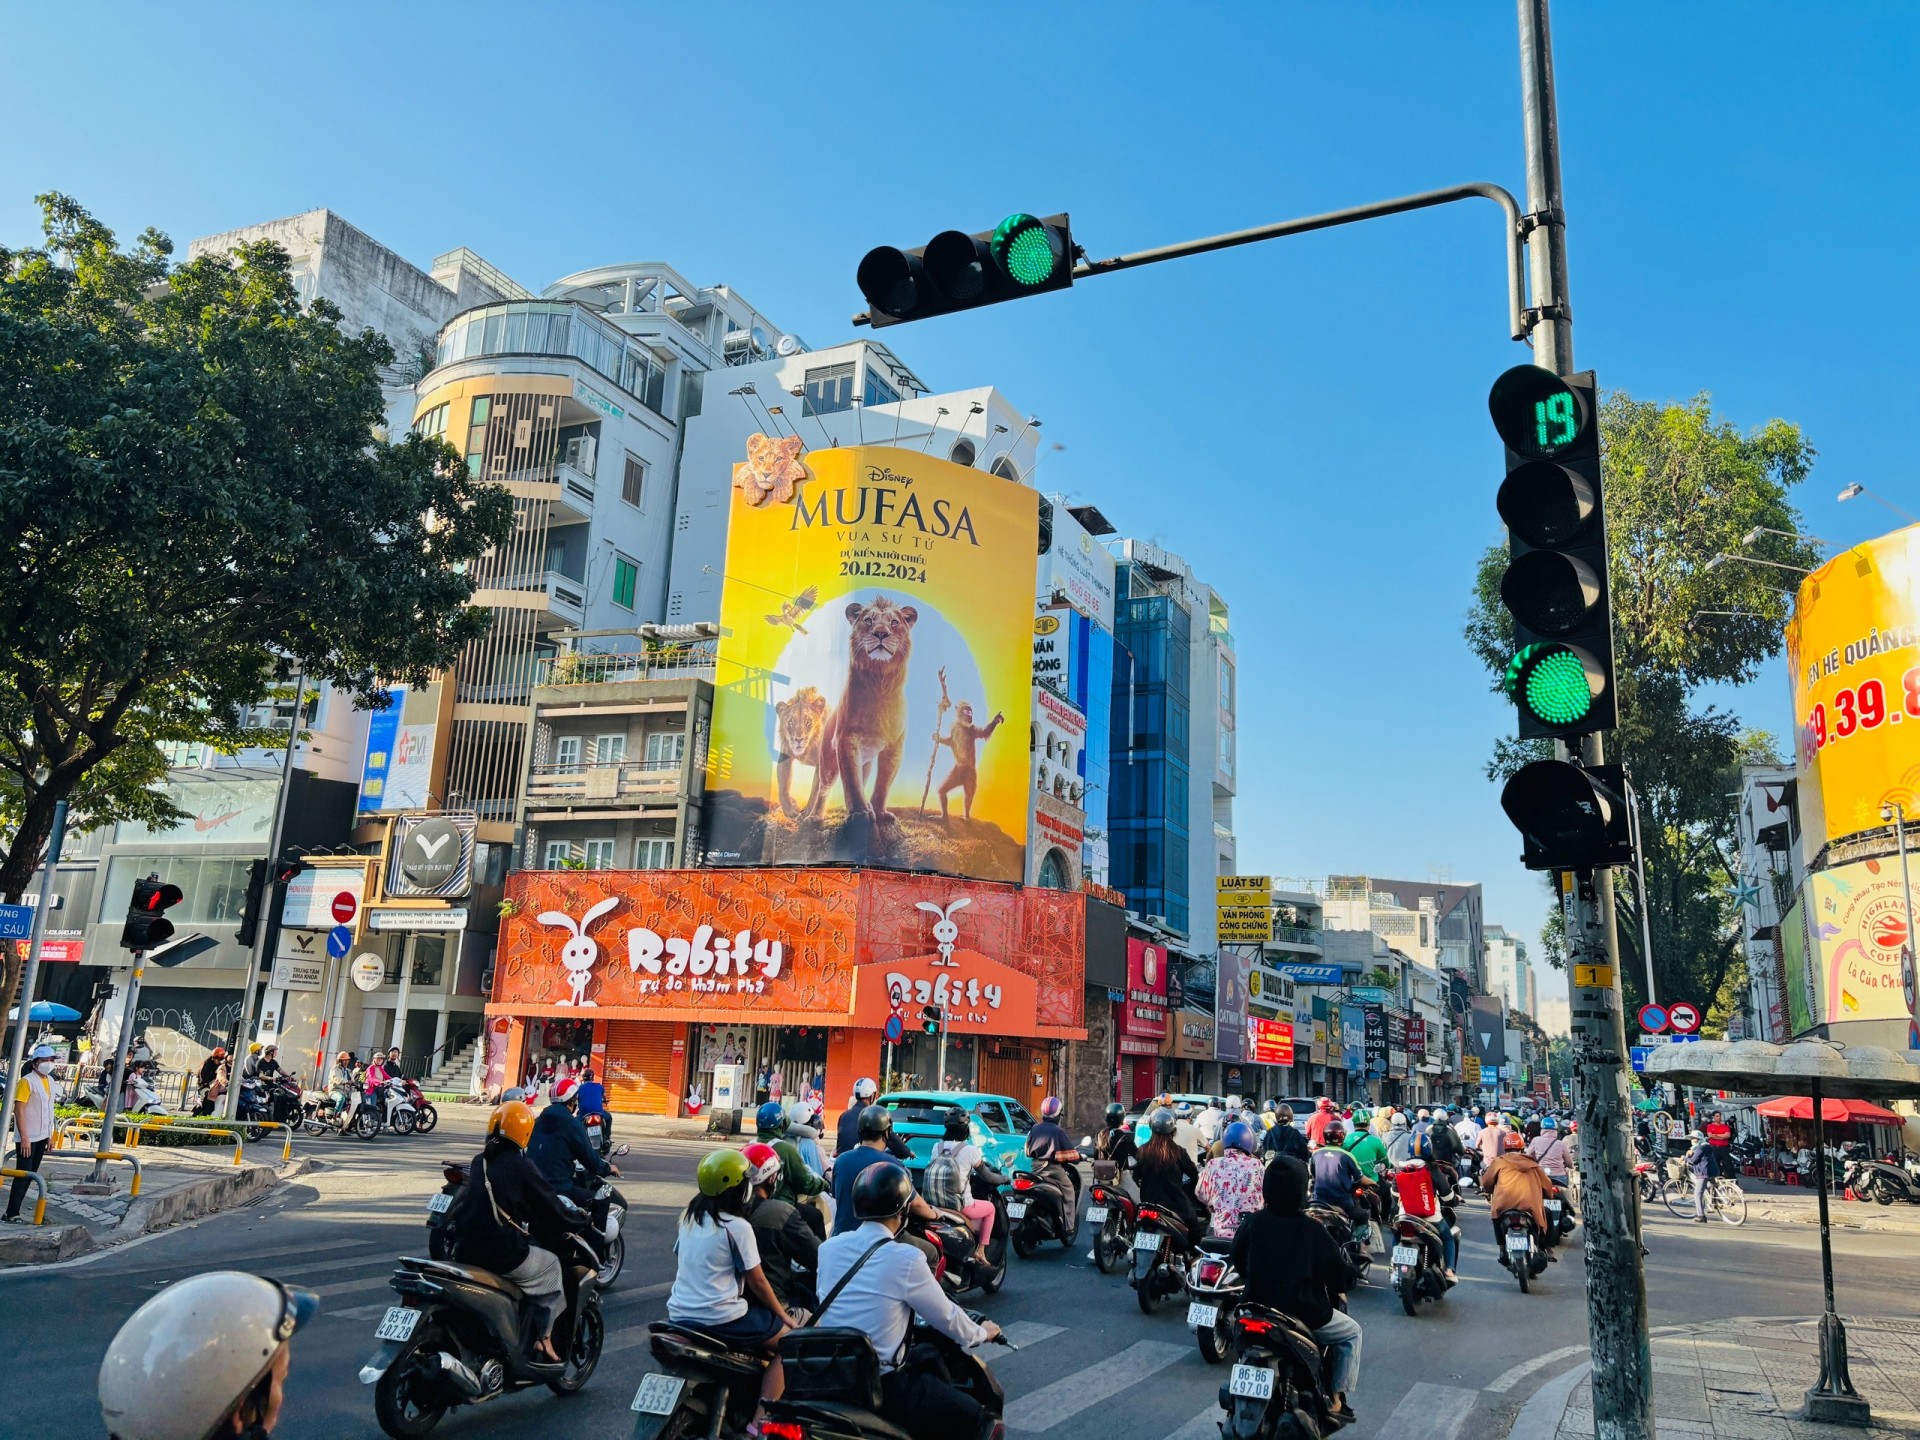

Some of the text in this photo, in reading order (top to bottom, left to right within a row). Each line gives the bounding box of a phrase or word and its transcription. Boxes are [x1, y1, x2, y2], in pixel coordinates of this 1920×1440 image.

[1535, 391, 1576, 446] 19
[789, 487, 981, 547] MUFASA
[837, 531, 934, 550] VUA SƯ TỬ
[839, 561, 927, 583] 20.12.2024
[1823, 648, 1840, 675] HỆ
[1844, 628, 1917, 666] QUẢNG
[1032, 657, 1061, 672] HÒNG
[1221, 876, 1264, 890] LUẬT SƯ
[3, 921, 24, 935] SÁU
[628, 925, 782, 978] Rabity
[1870, 949, 1900, 962] COFF
[1280, 965, 1337, 976] GIANT
[1589, 968, 1597, 983] 1
[1881, 973, 1904, 989] Chú
[1411, 1020, 1421, 1029] XE
[1366, 1051, 1381, 1059] XE
[388, 1310, 414, 1323] 65-H1
[1238, 1368, 1267, 1383] 86-B6
[1232, 1380, 1270, 1397] 497.08
